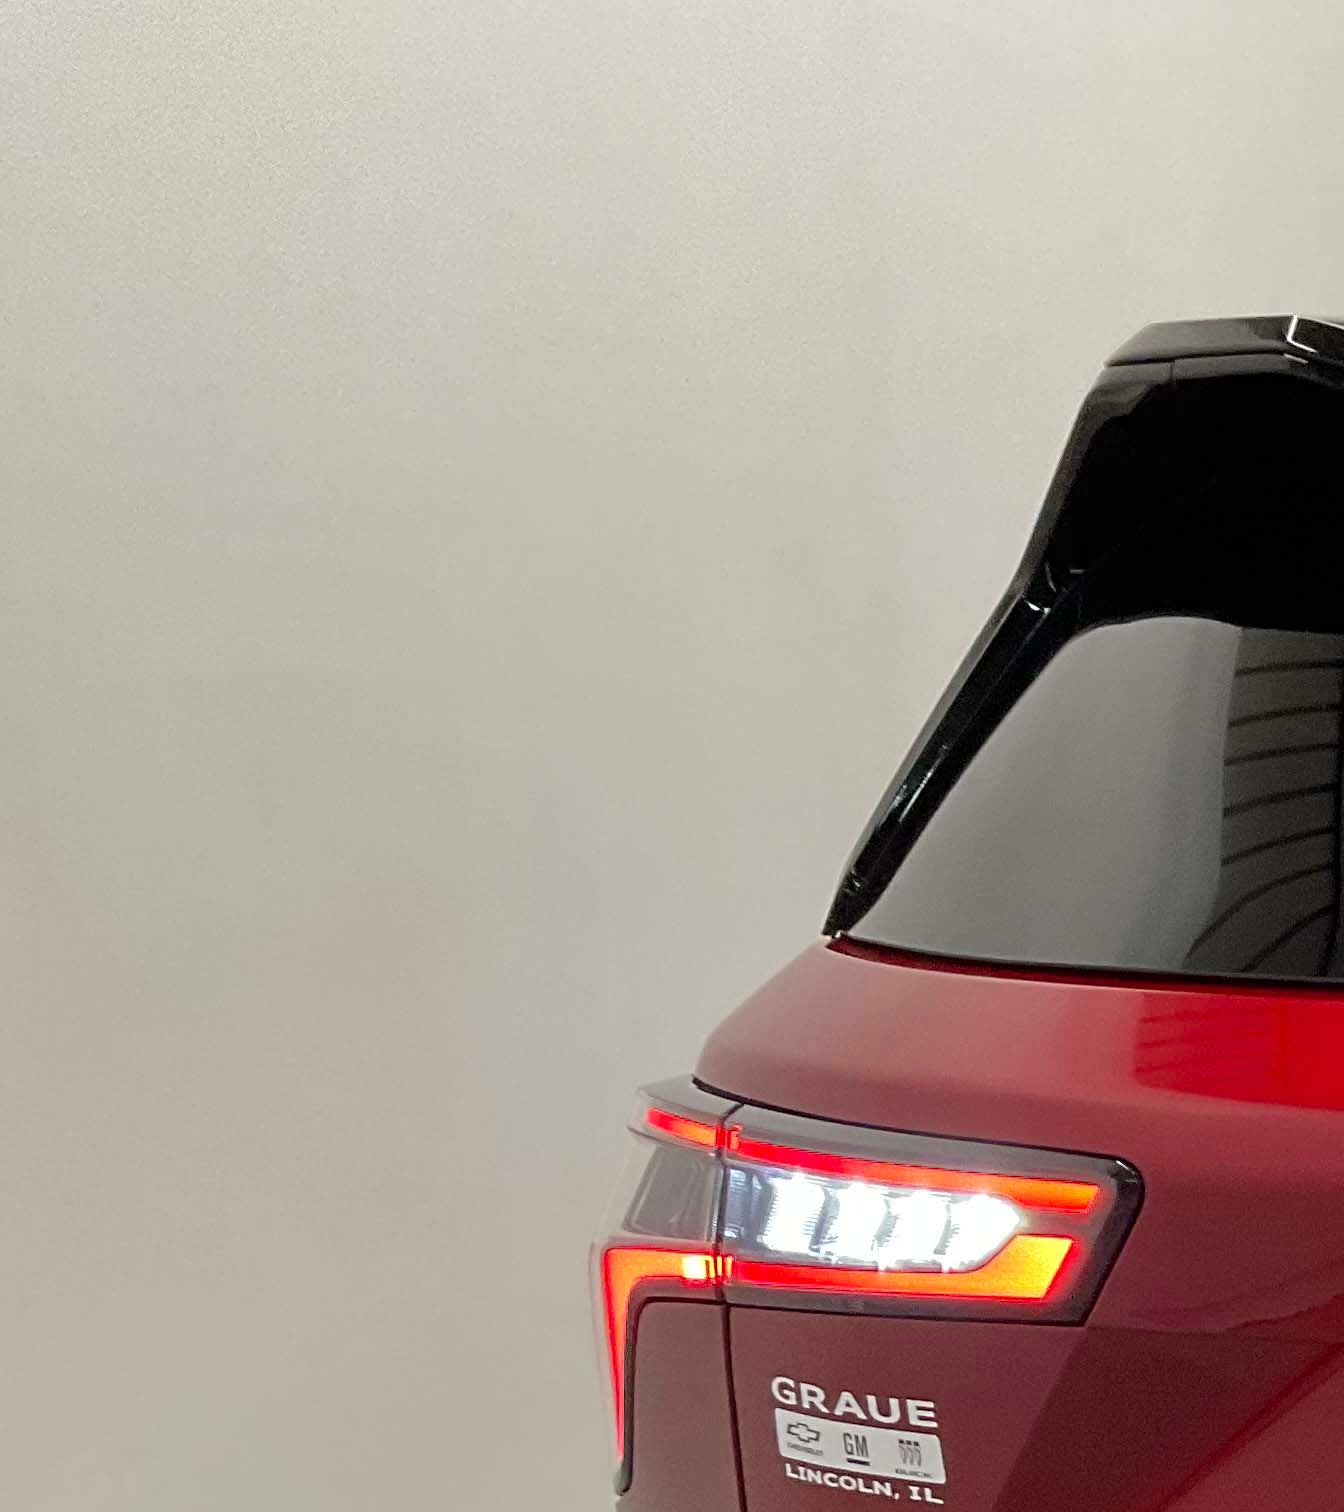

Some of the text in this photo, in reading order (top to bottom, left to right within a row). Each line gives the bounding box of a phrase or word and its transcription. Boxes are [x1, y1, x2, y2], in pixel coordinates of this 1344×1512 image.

[771, 1376, 938, 1428] GRAUE
[843, 1432, 869, 1458] GM
[785, 1463, 944, 1504] LINCOLN, IL
